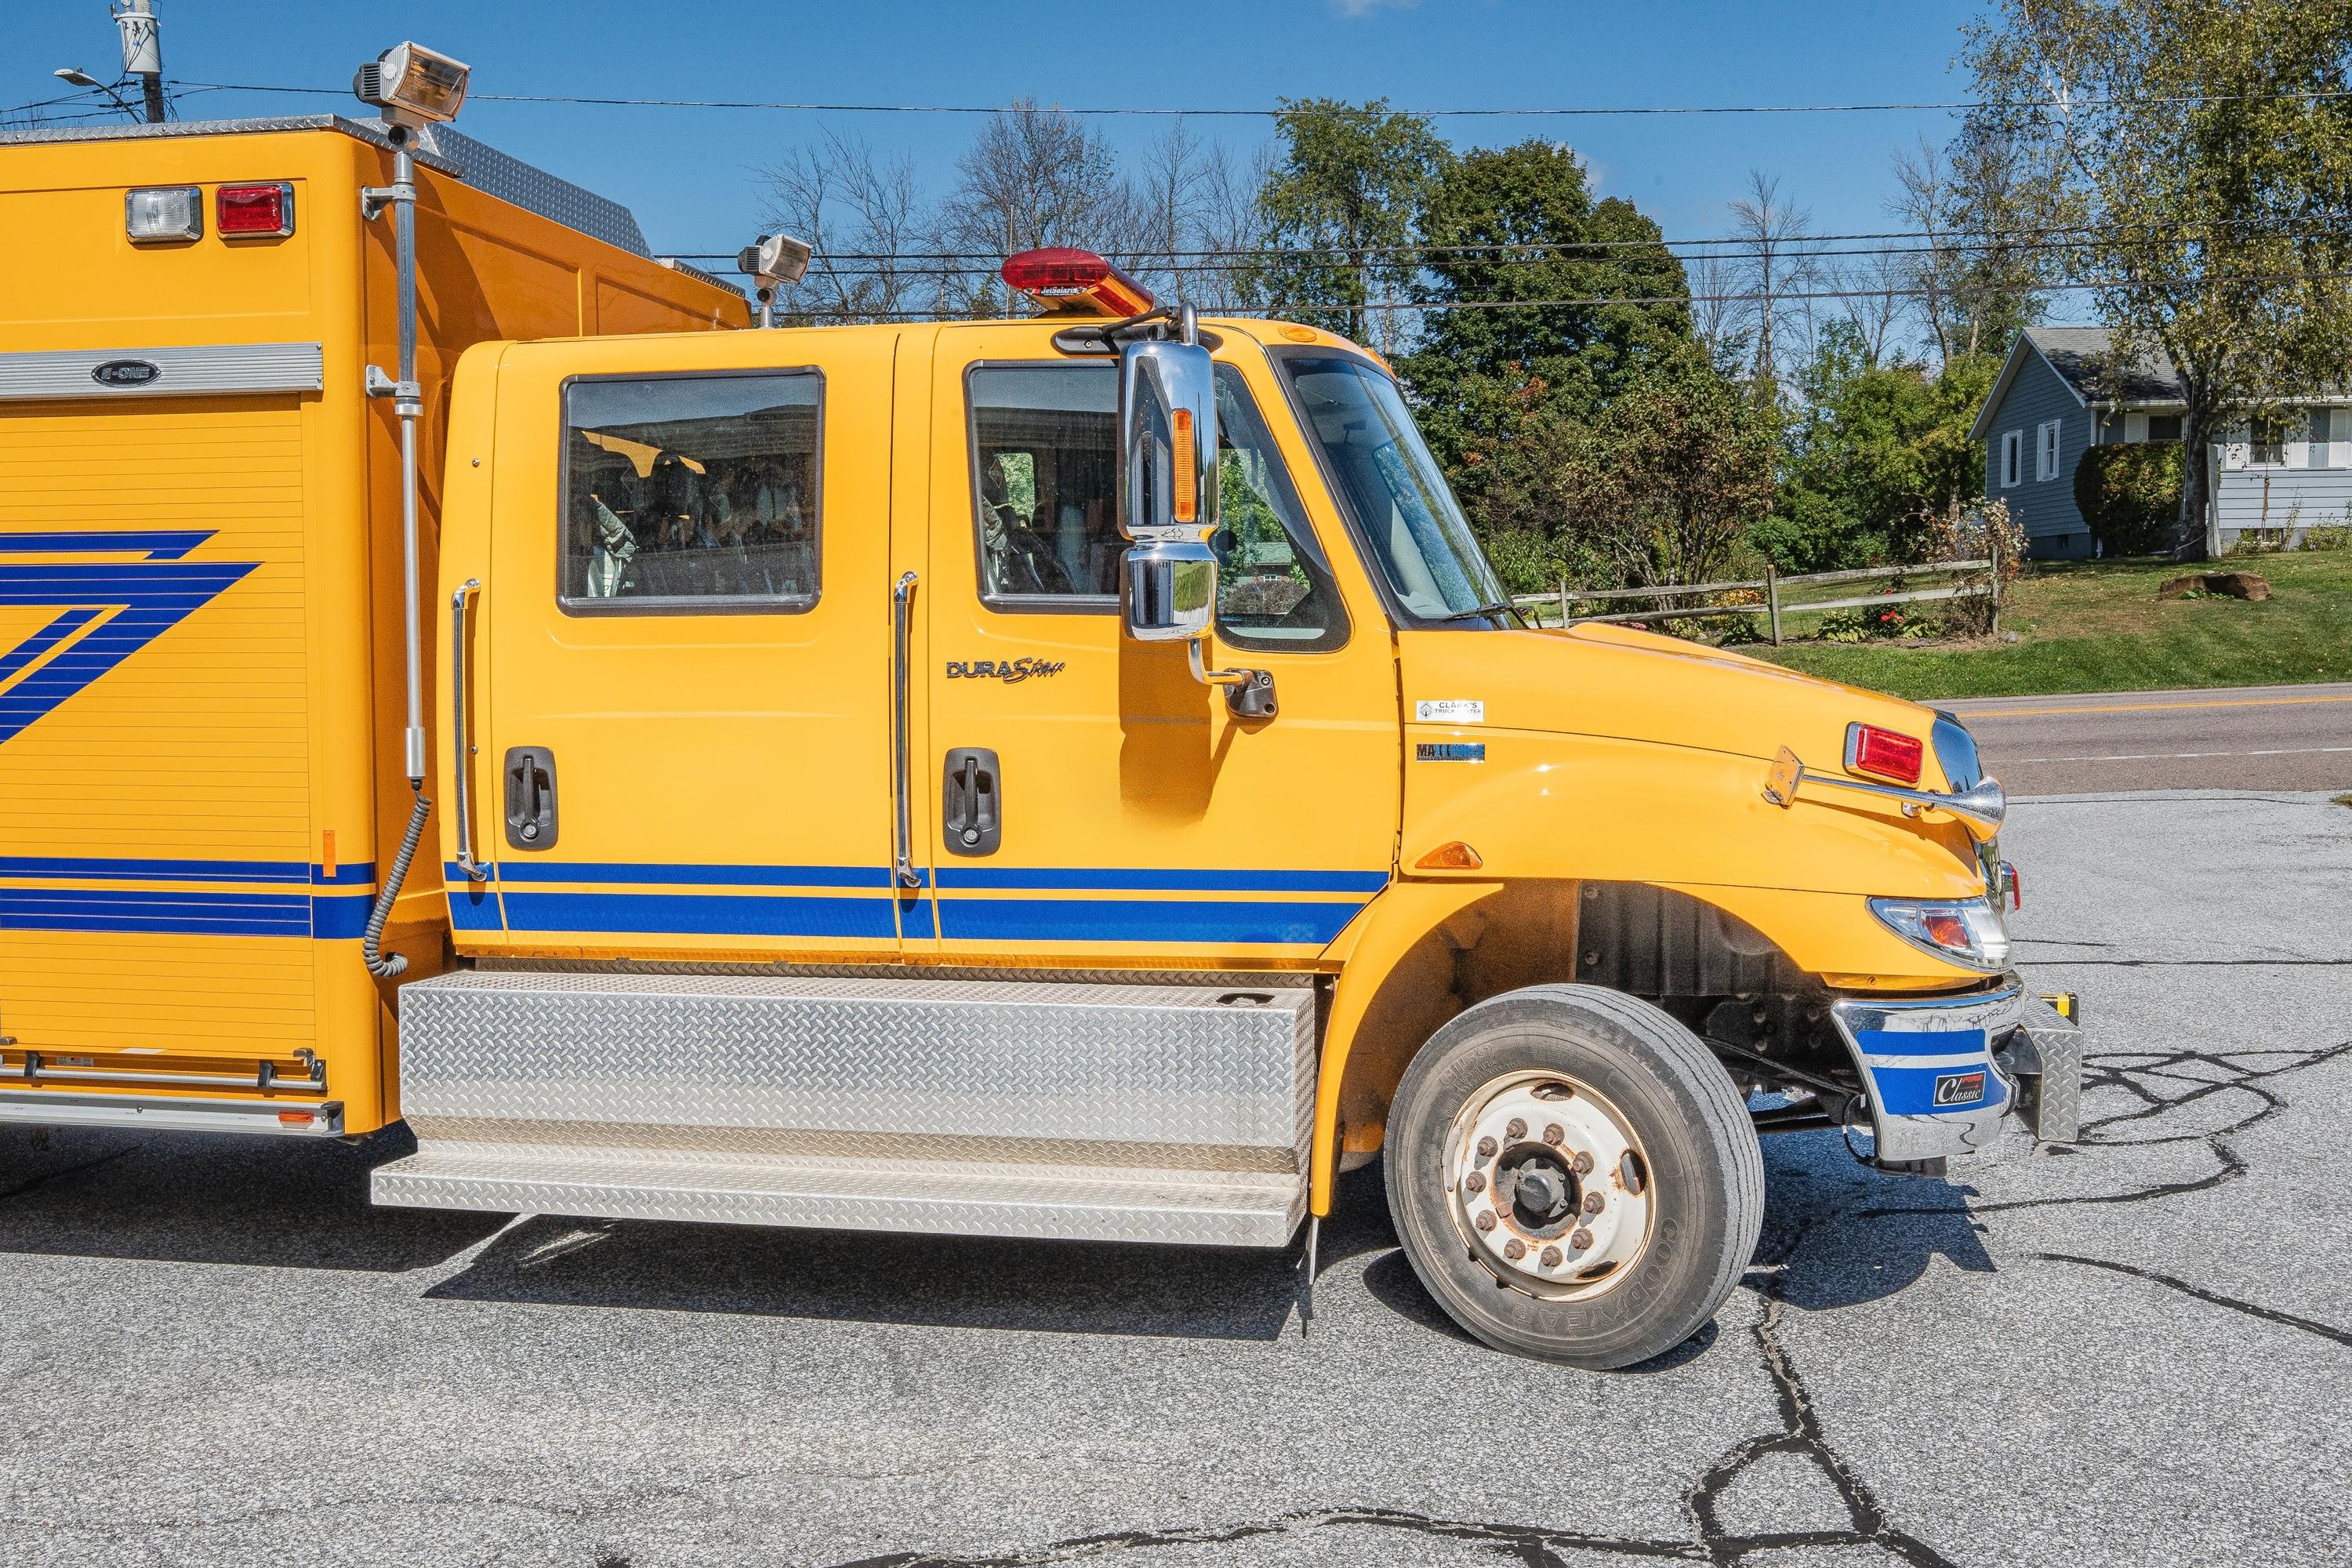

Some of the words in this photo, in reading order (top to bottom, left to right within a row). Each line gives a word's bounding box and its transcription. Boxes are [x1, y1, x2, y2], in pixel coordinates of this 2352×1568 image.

[1937, 1077, 1981, 1103] Classic
[1962, 1074, 1984, 1083] FIRE
[1512, 1218, 1678, 1330] GOODYEAR
